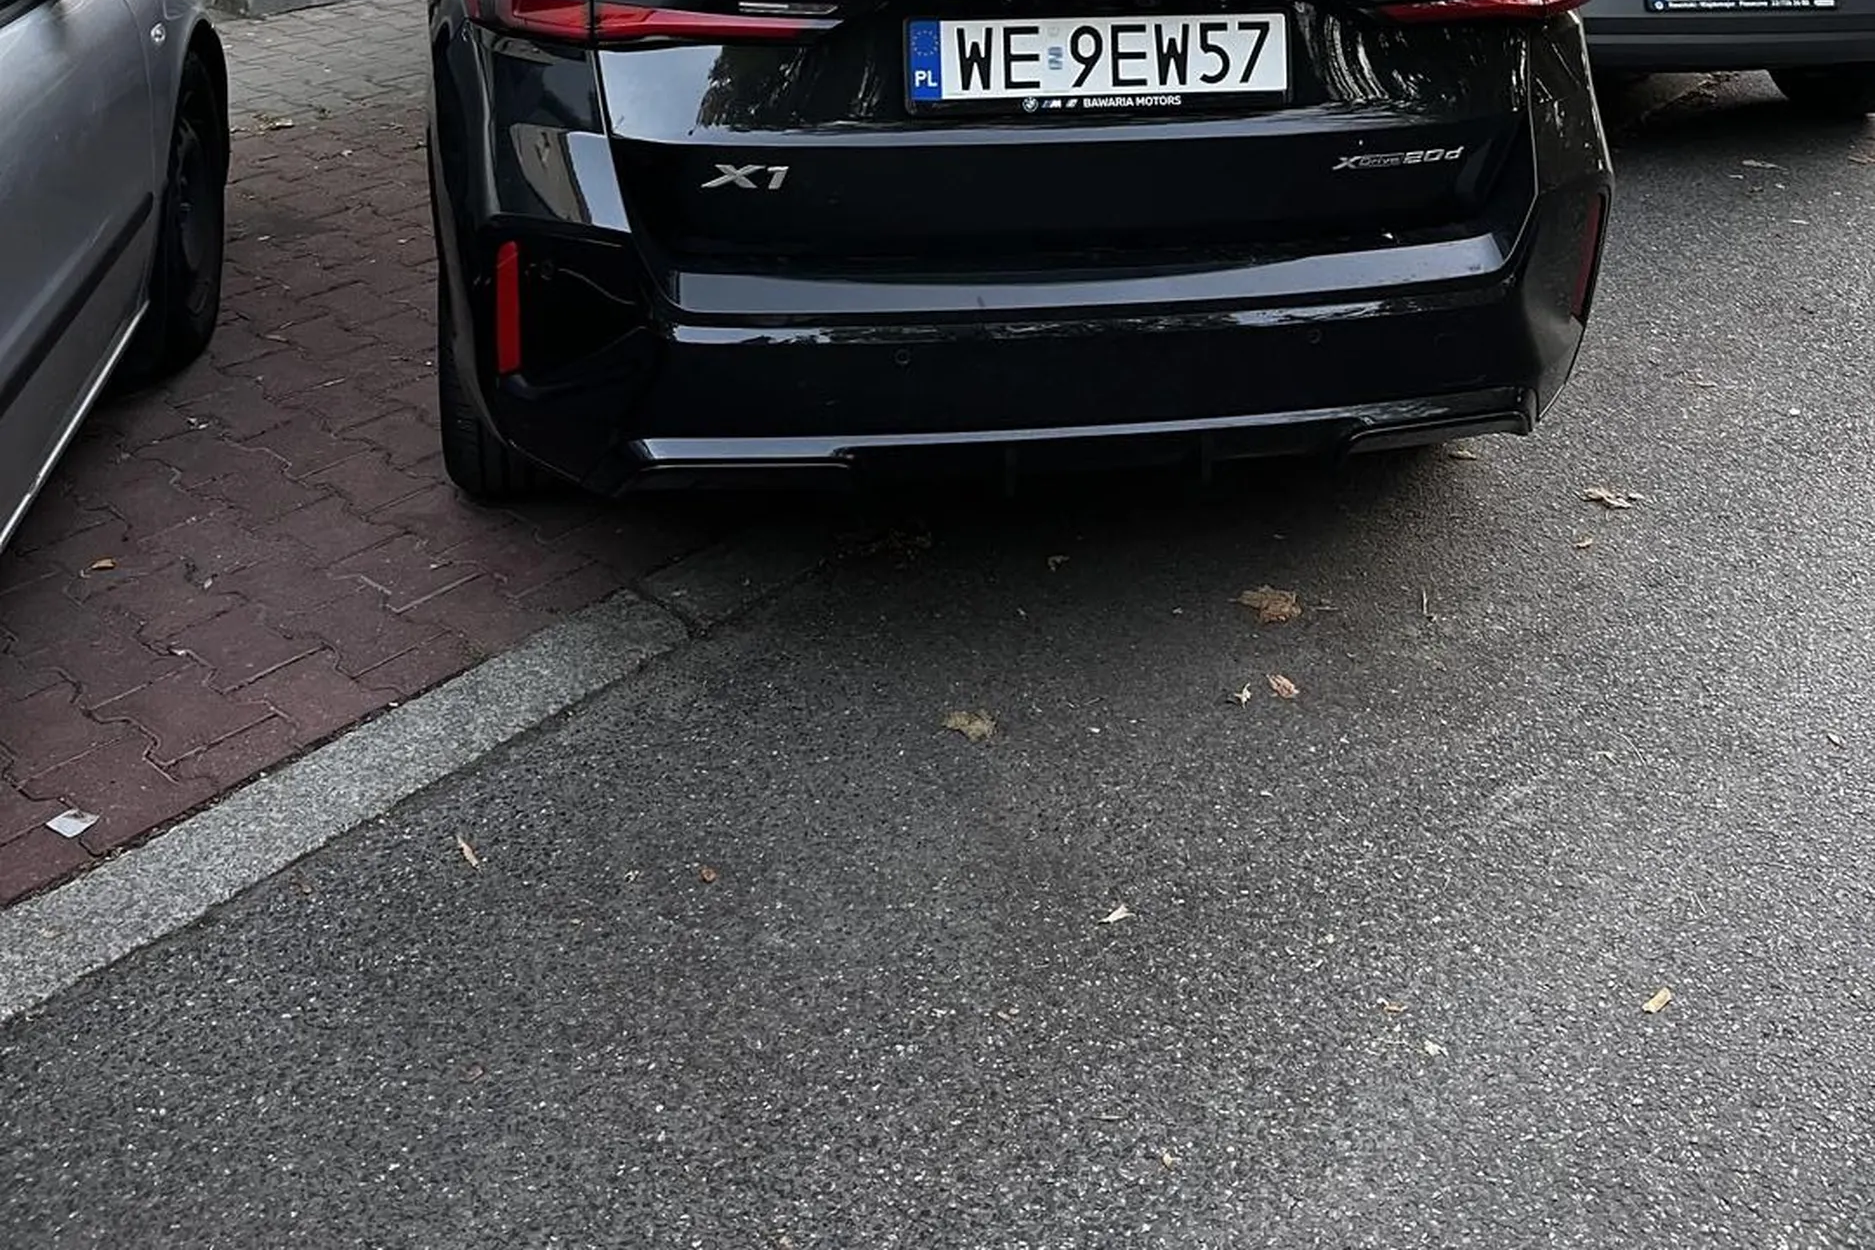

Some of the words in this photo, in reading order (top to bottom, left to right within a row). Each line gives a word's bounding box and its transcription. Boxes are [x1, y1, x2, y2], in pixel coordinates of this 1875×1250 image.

[955, 25, 1041, 91] WE
[1069, 21, 1270, 88] 9EW57
[914, 69, 938, 87] PL
[1083, 97, 1134, 109] BAWARIA
[1135, 95, 1182, 107] MOTORS
[700, 163, 790, 190] X1
